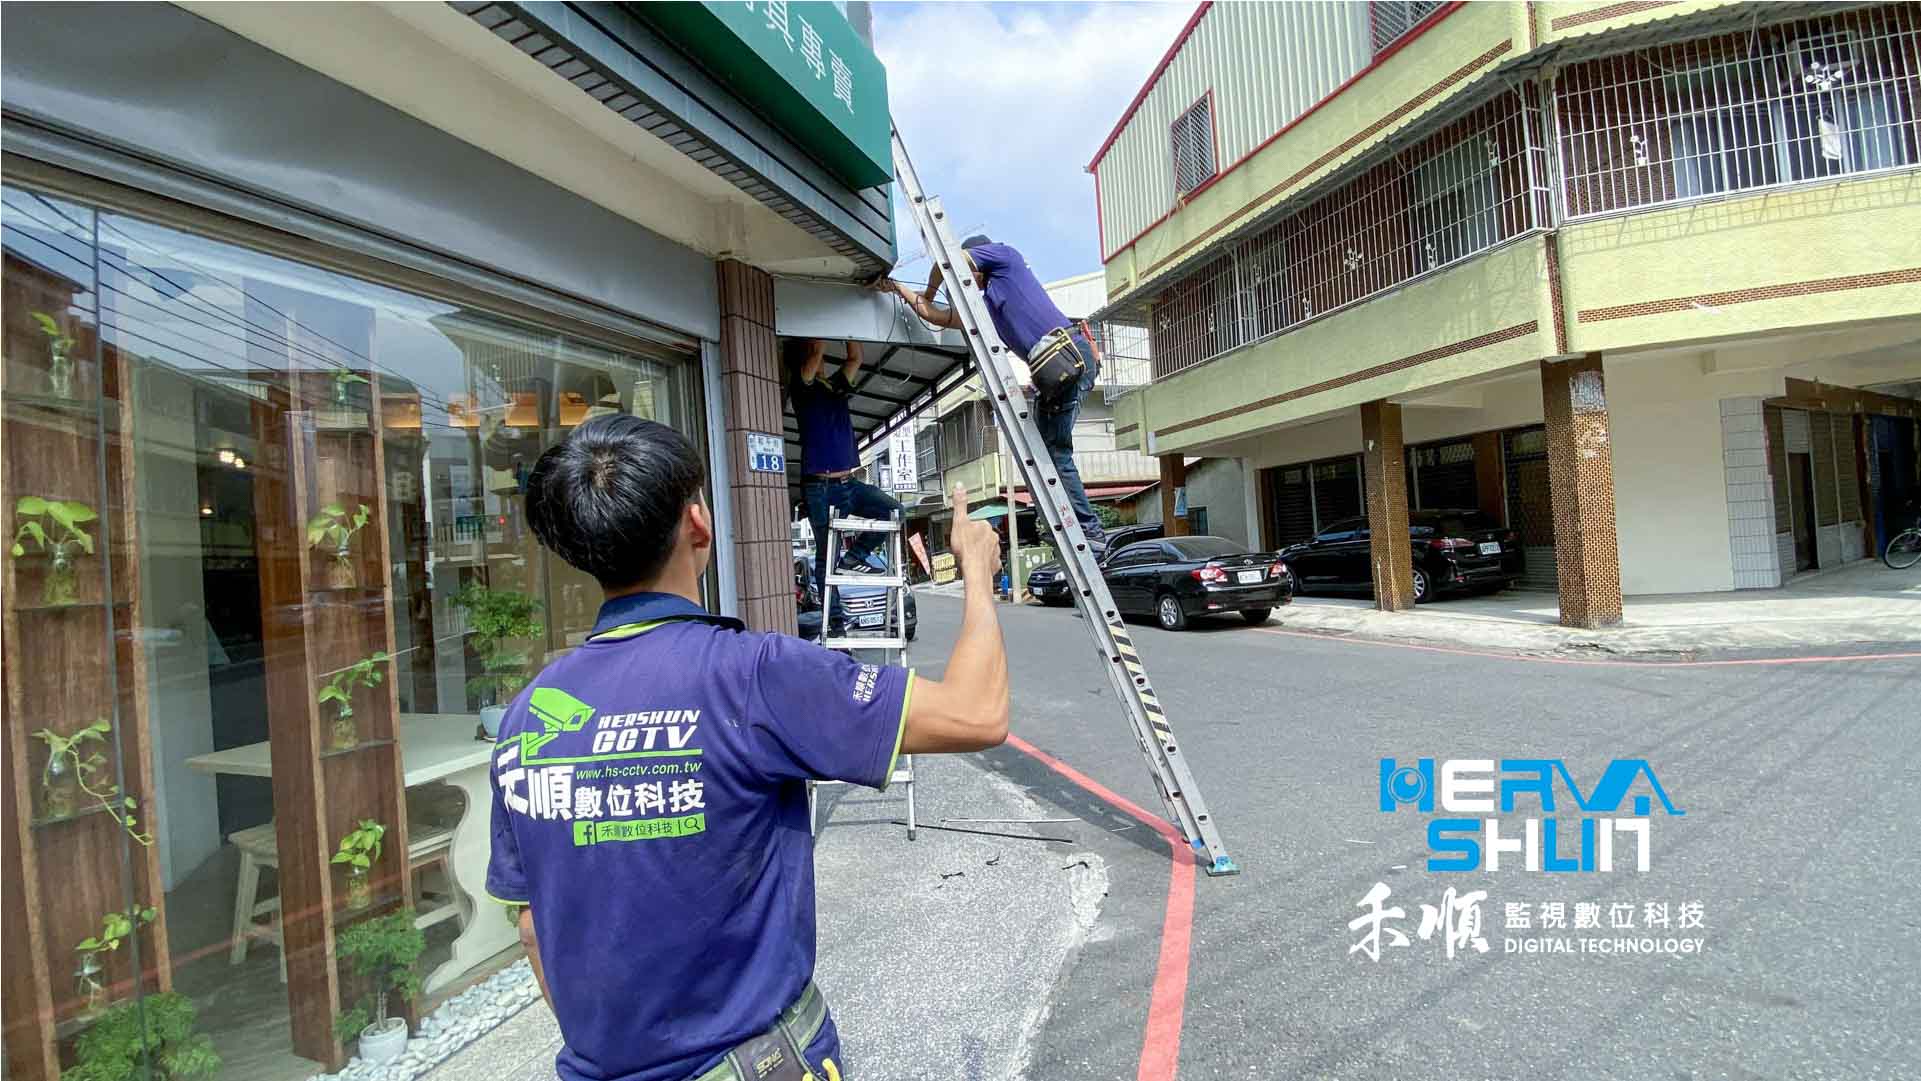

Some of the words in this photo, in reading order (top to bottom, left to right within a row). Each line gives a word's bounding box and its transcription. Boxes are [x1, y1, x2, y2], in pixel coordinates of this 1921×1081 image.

[744, 0, 854, 115] 具專賣
[761, 455, 780, 471] 18
[598, 709, 701, 729] HERSHUN
[592, 725, 698, 753] CCTV
[576, 761, 702, 780] www.hs-cctv.com.tw
[574, 778, 706, 819] 數位科技
